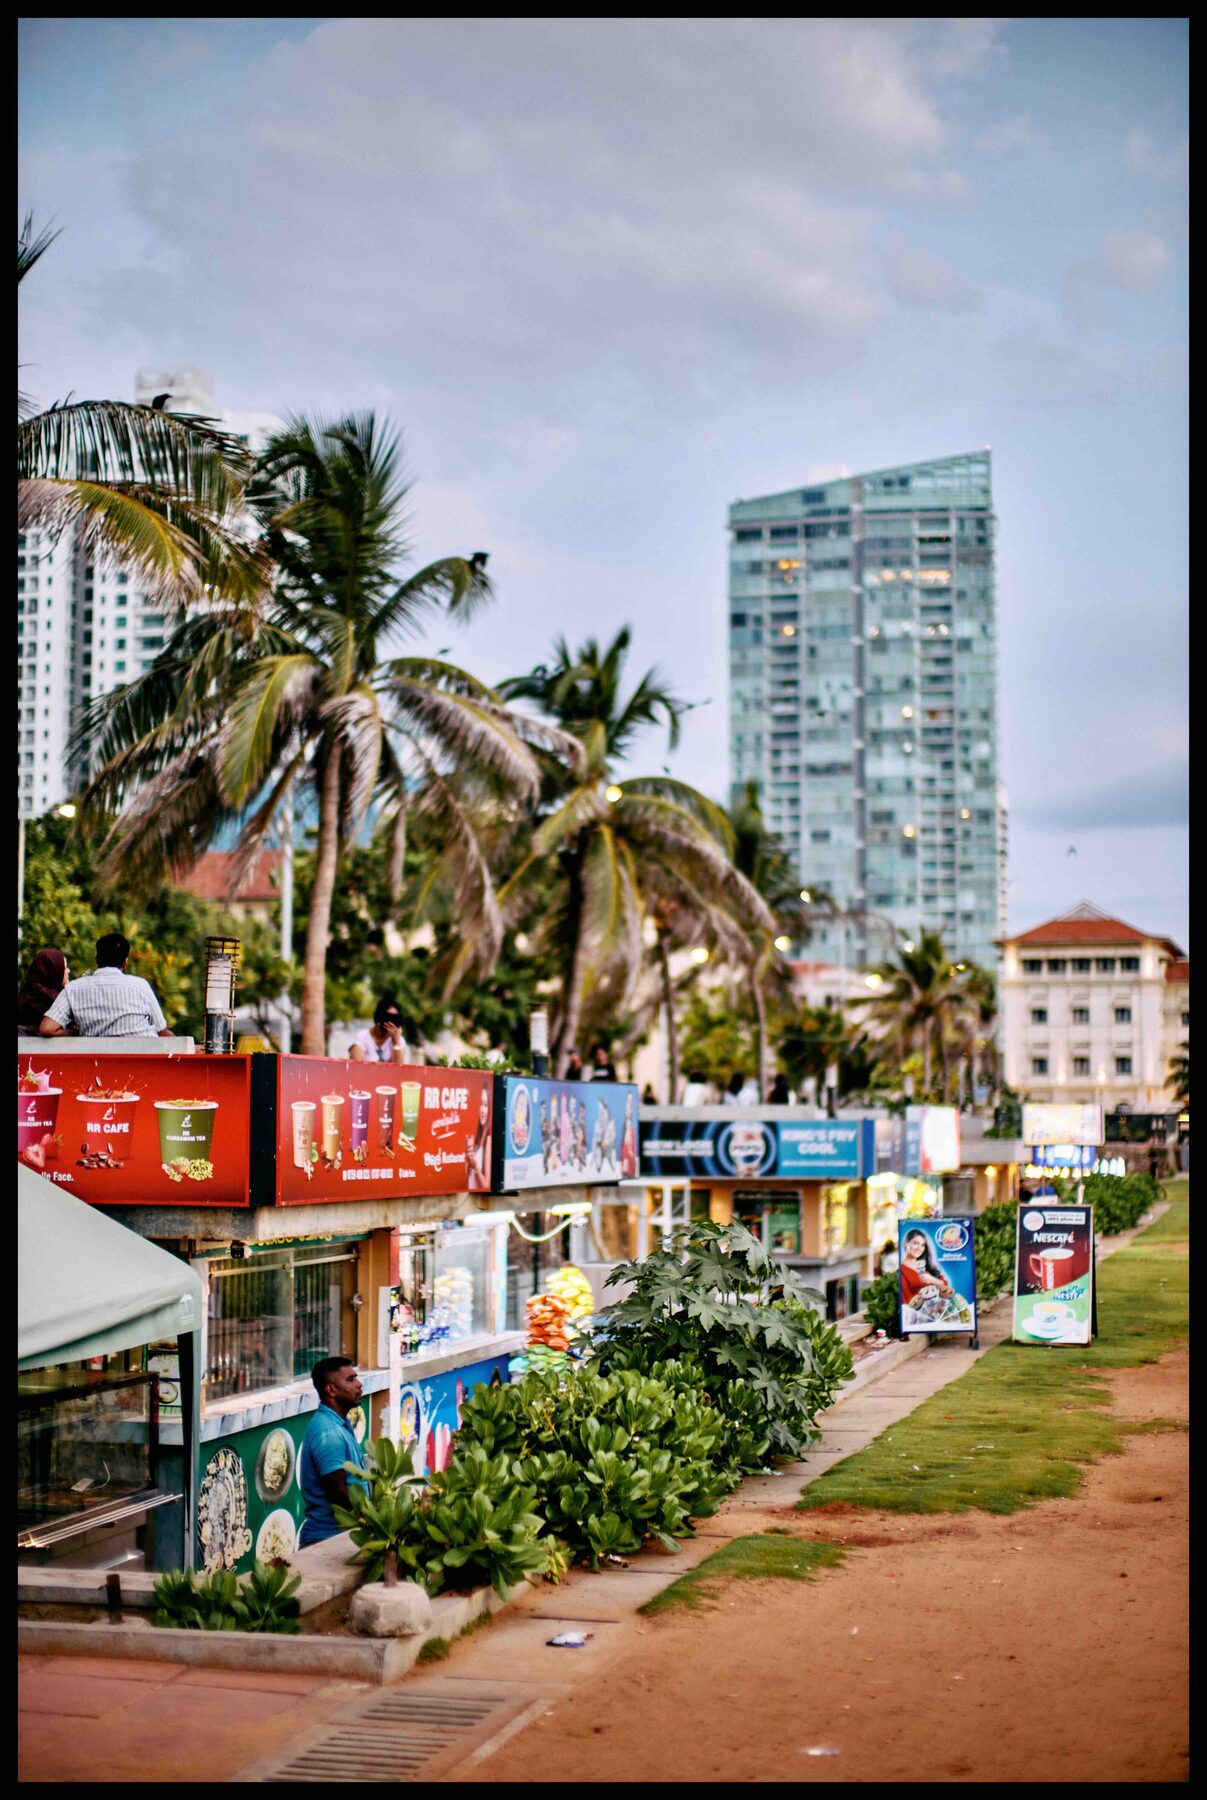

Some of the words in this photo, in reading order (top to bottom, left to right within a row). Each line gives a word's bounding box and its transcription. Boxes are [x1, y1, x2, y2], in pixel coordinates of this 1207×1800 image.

[424, 1087, 440, 1109] RR
[441, 1087, 468, 1110] CAFE
[87, 1123, 101, 1133] RR
[103, 1122, 129, 1133] CAFE
[53, 1172, 74, 1182] Face.
[1033, 1231, 1076, 1243] NESCAFÉ
